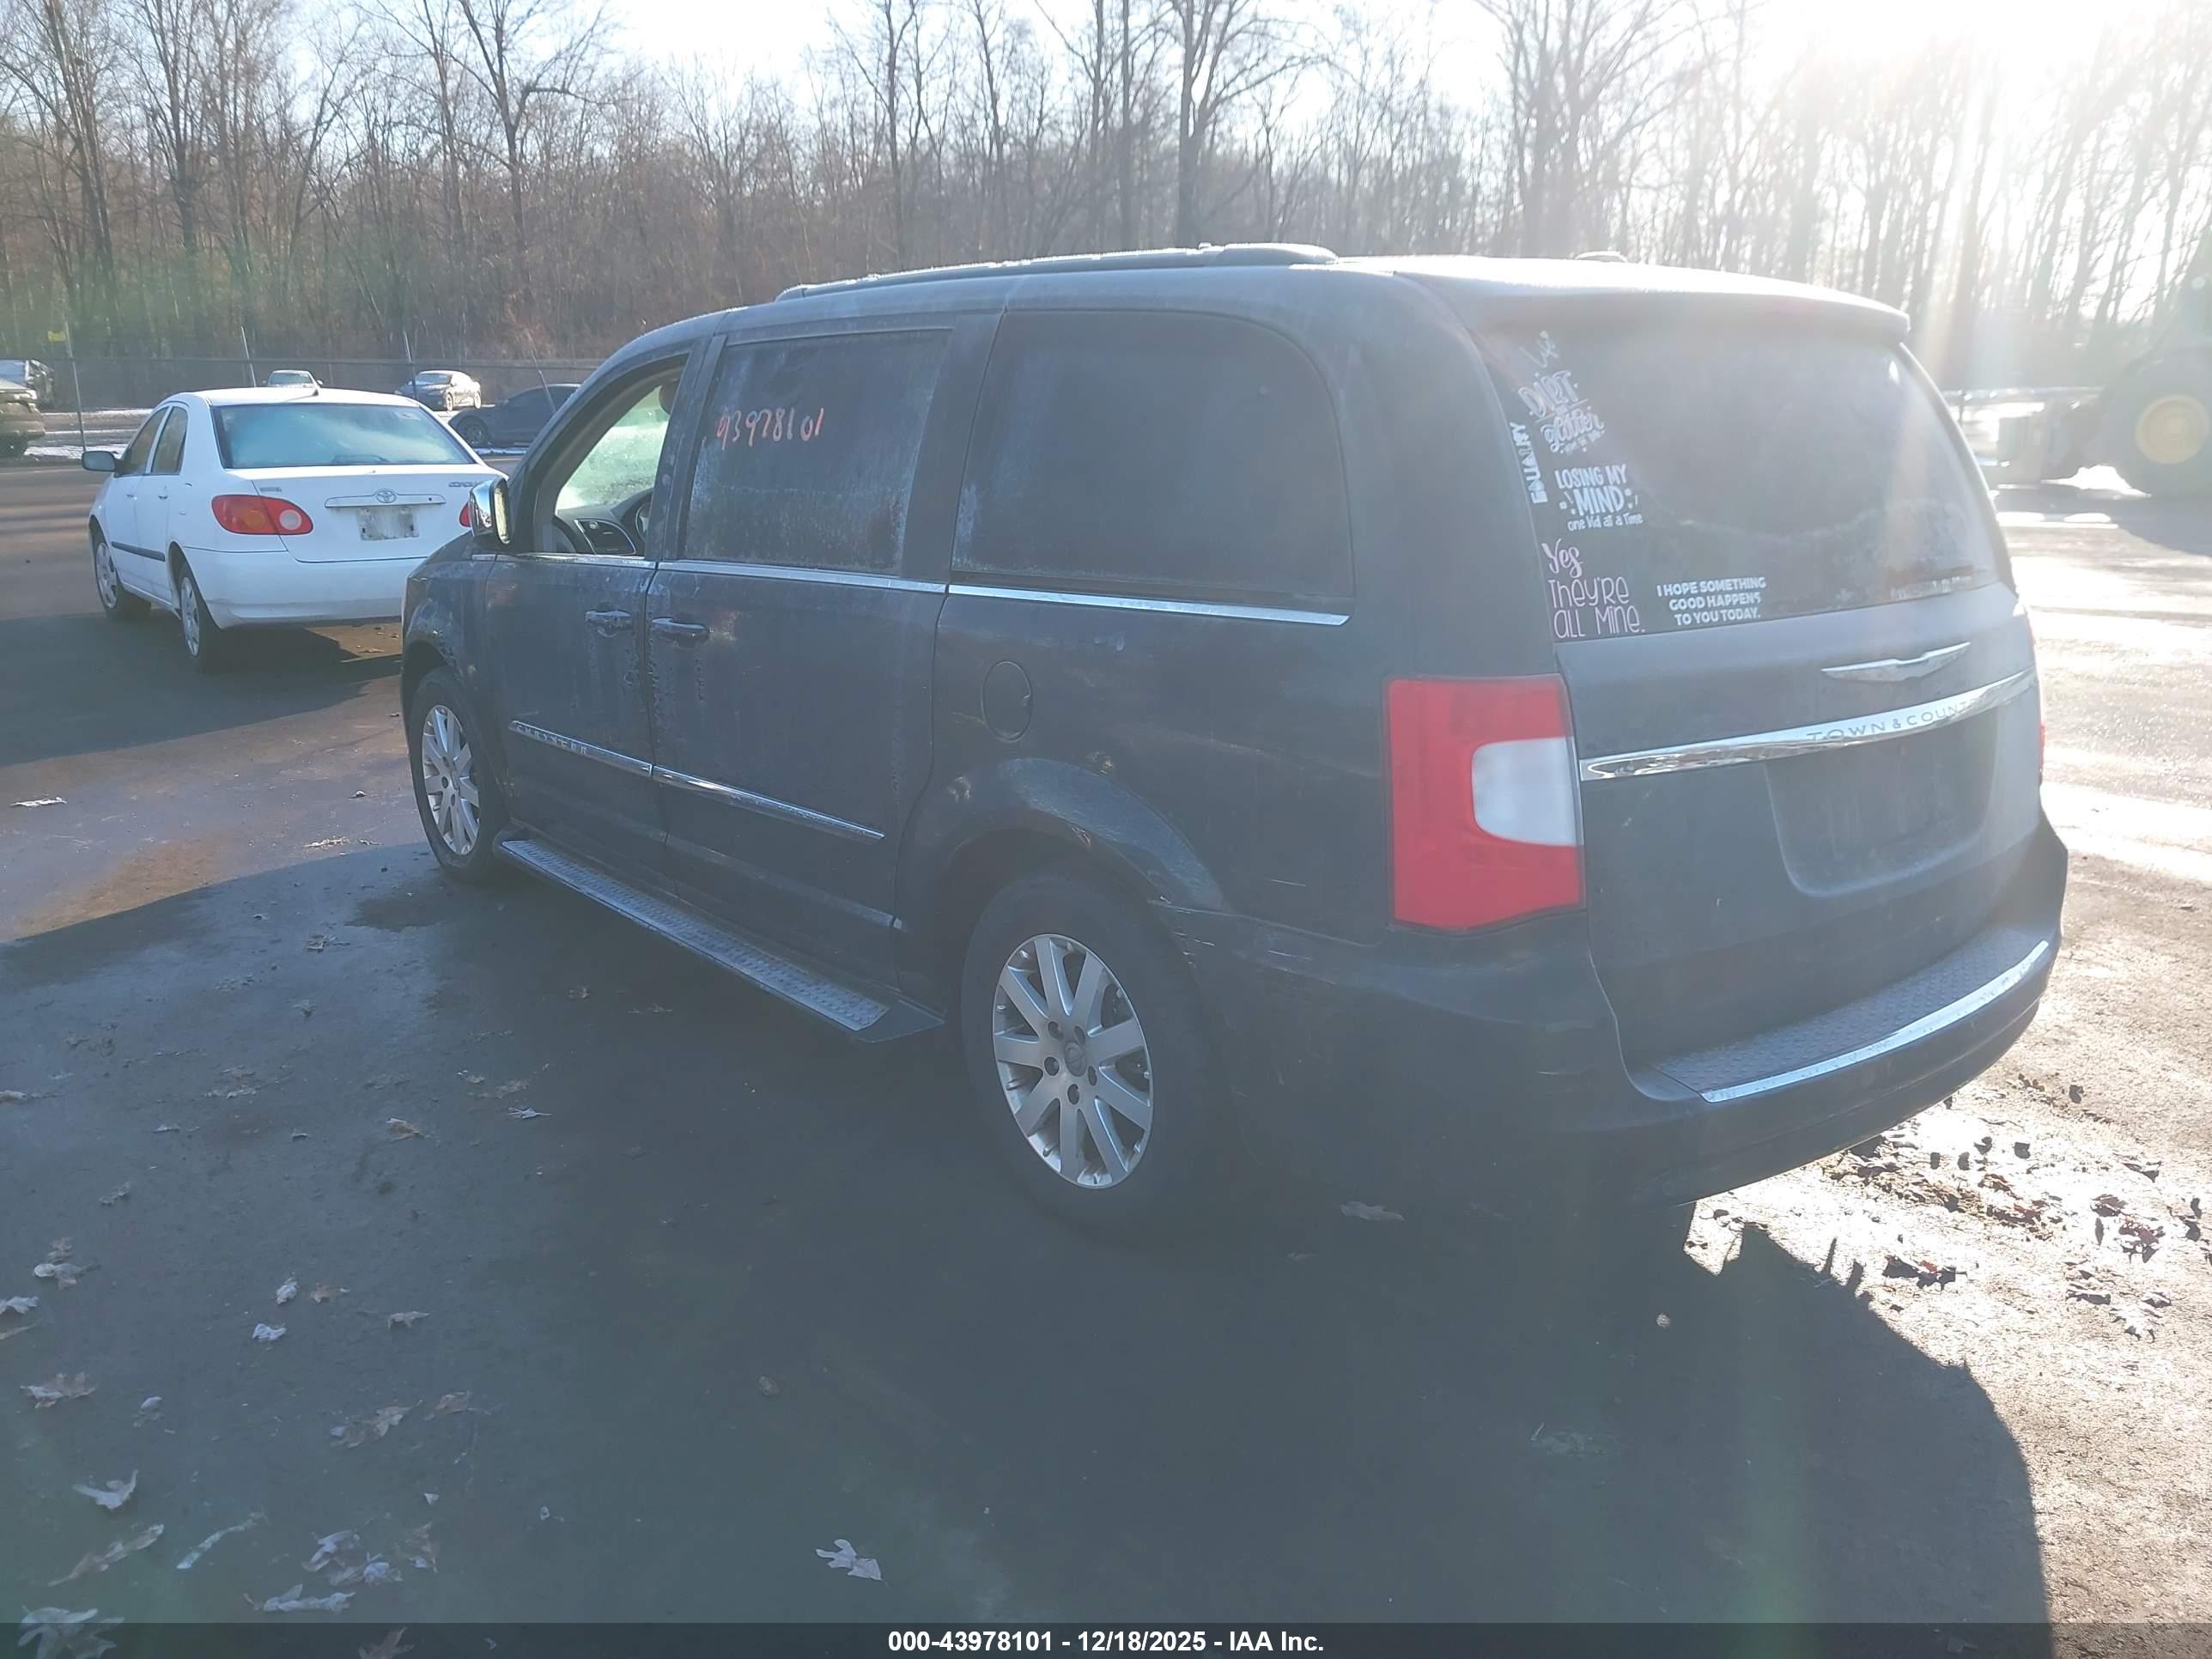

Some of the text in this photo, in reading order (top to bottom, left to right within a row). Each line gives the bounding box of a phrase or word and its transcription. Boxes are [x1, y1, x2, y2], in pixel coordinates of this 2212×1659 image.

[1554, 464, 1627, 489] LOSING MY
[1573, 485, 1626, 516] MIND
[1541, 538, 1583, 578] Yes
[1656, 576, 1766, 598] I HOPE SOMETHING
[1669, 592, 1761, 611] GOOD HAPPENS
[1674, 607, 1761, 626] TO YOU TODAY.
